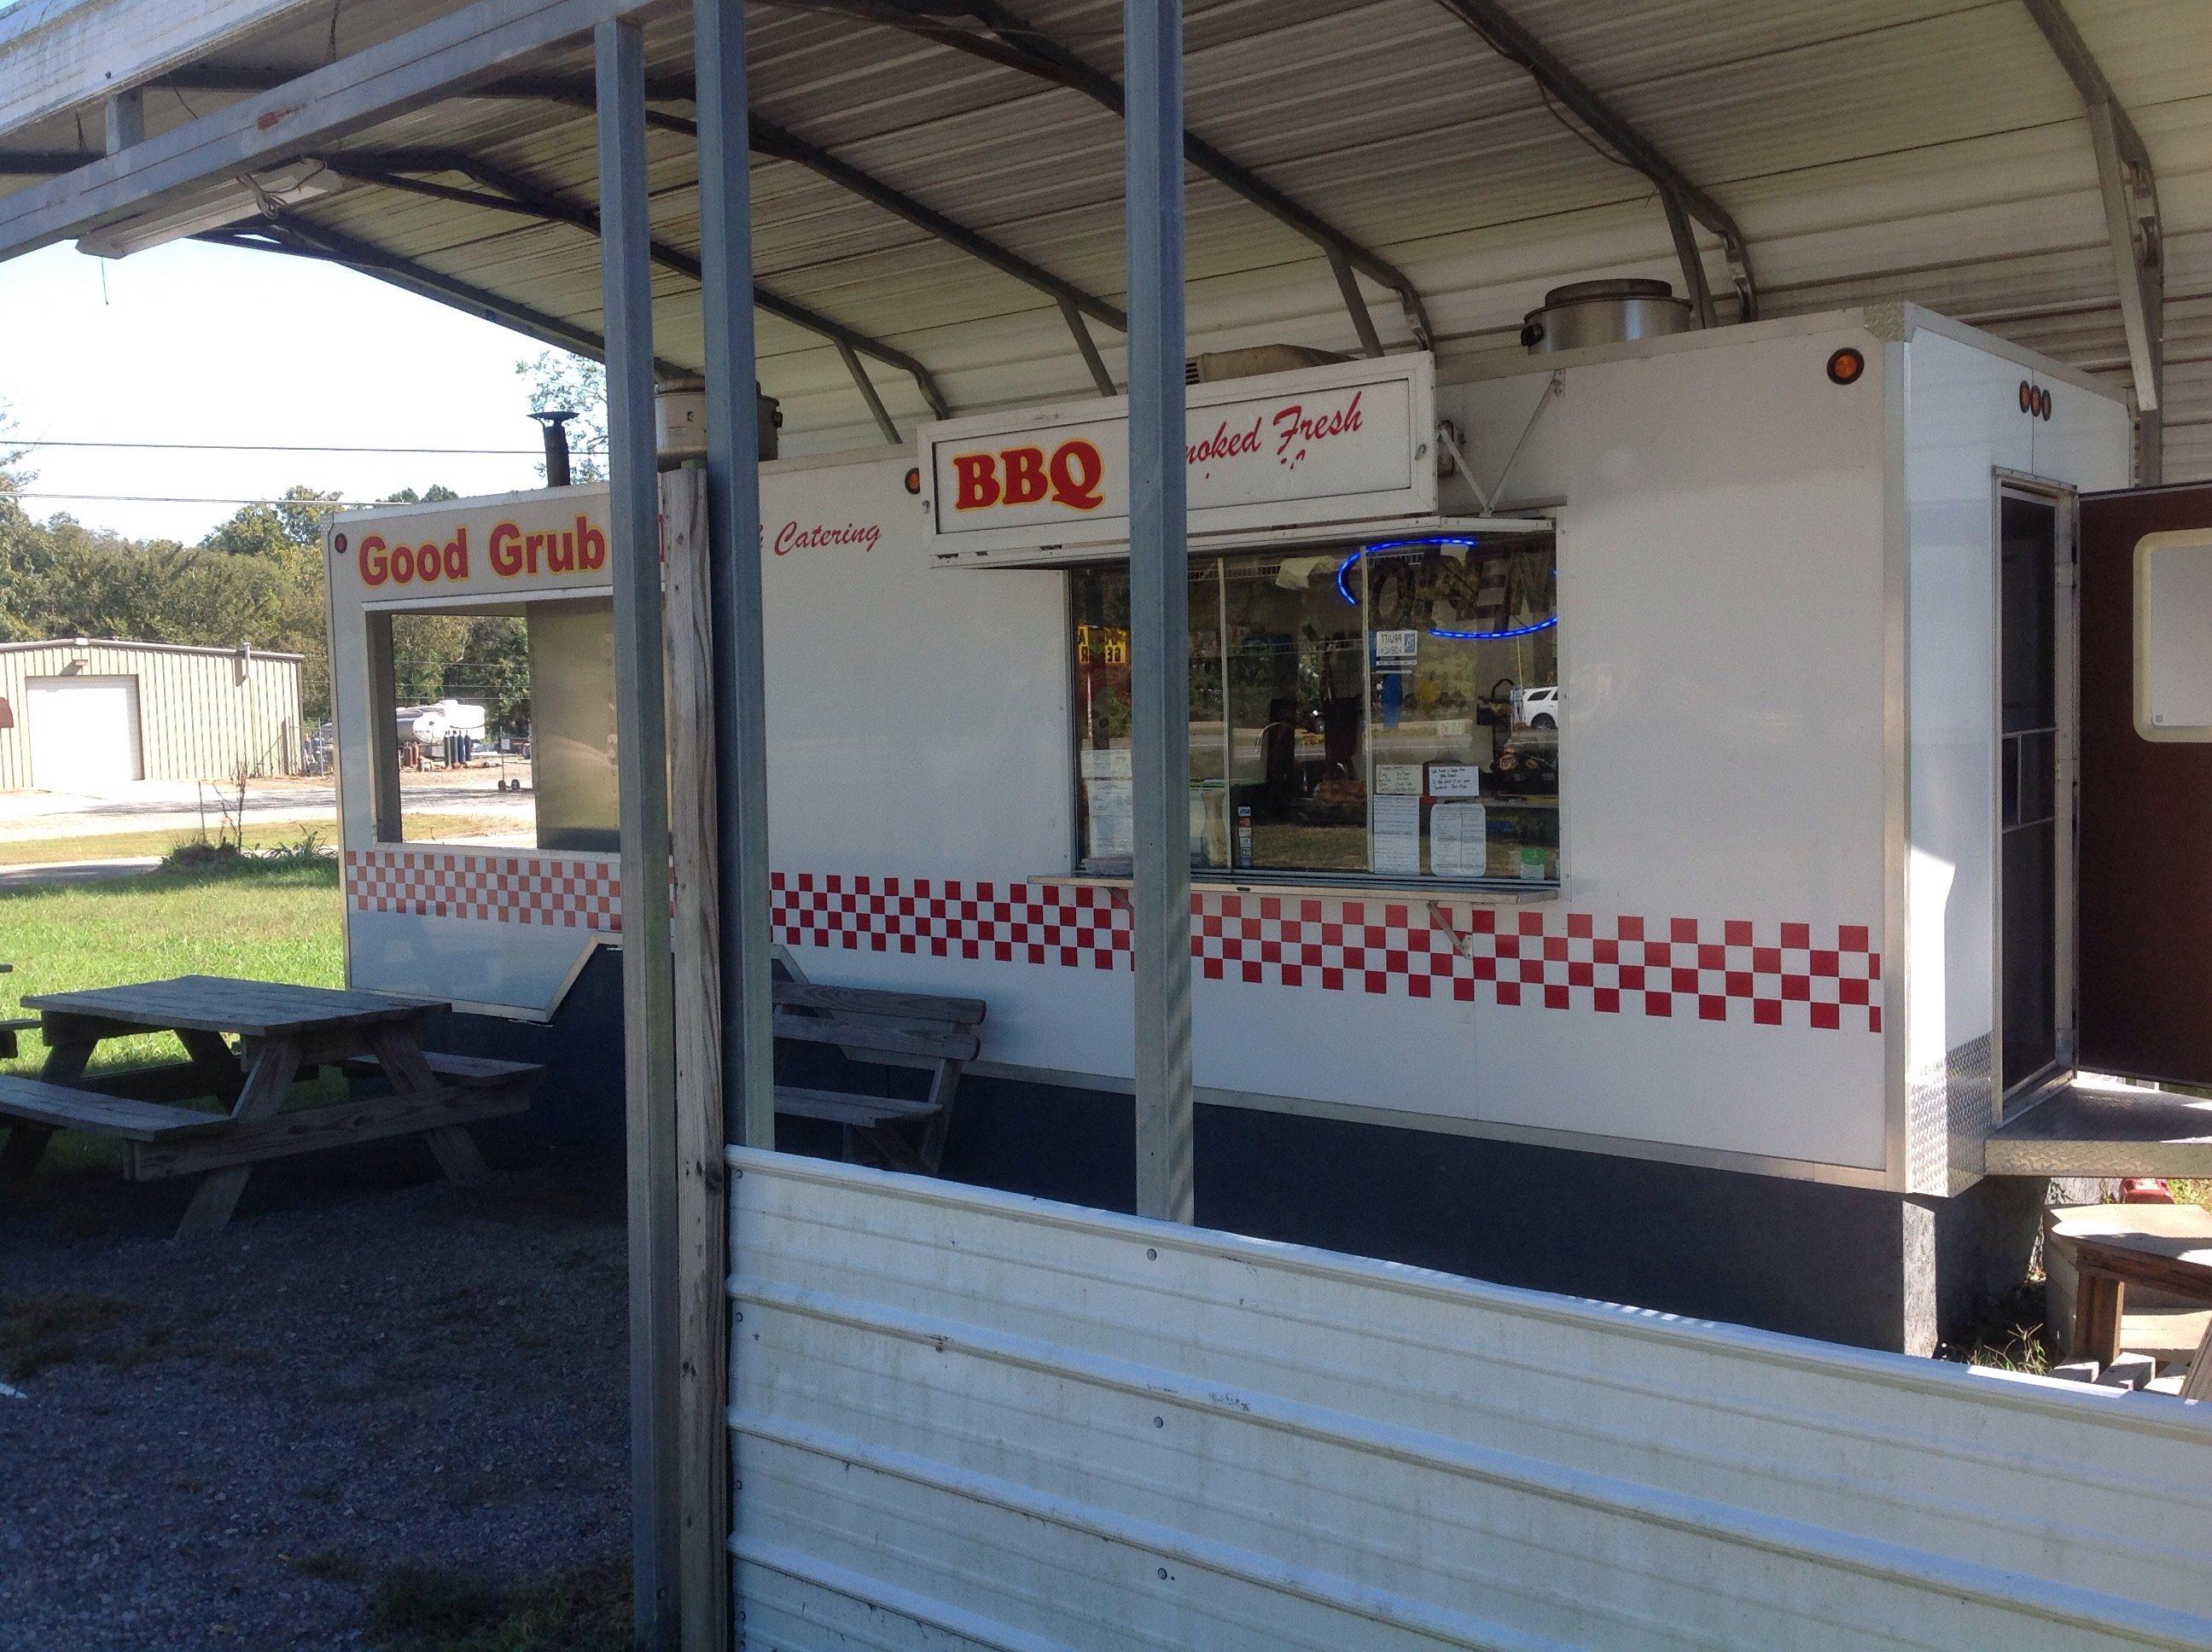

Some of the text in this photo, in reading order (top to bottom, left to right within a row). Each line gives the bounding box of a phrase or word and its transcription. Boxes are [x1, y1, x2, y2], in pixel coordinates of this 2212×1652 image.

[1272, 391, 1363, 456] Fresh
[953, 440, 1103, 509] BBQ
[358, 526, 469, 587] Good
[489, 515, 606, 577] Grub
[774, 521, 882, 556] Catering
